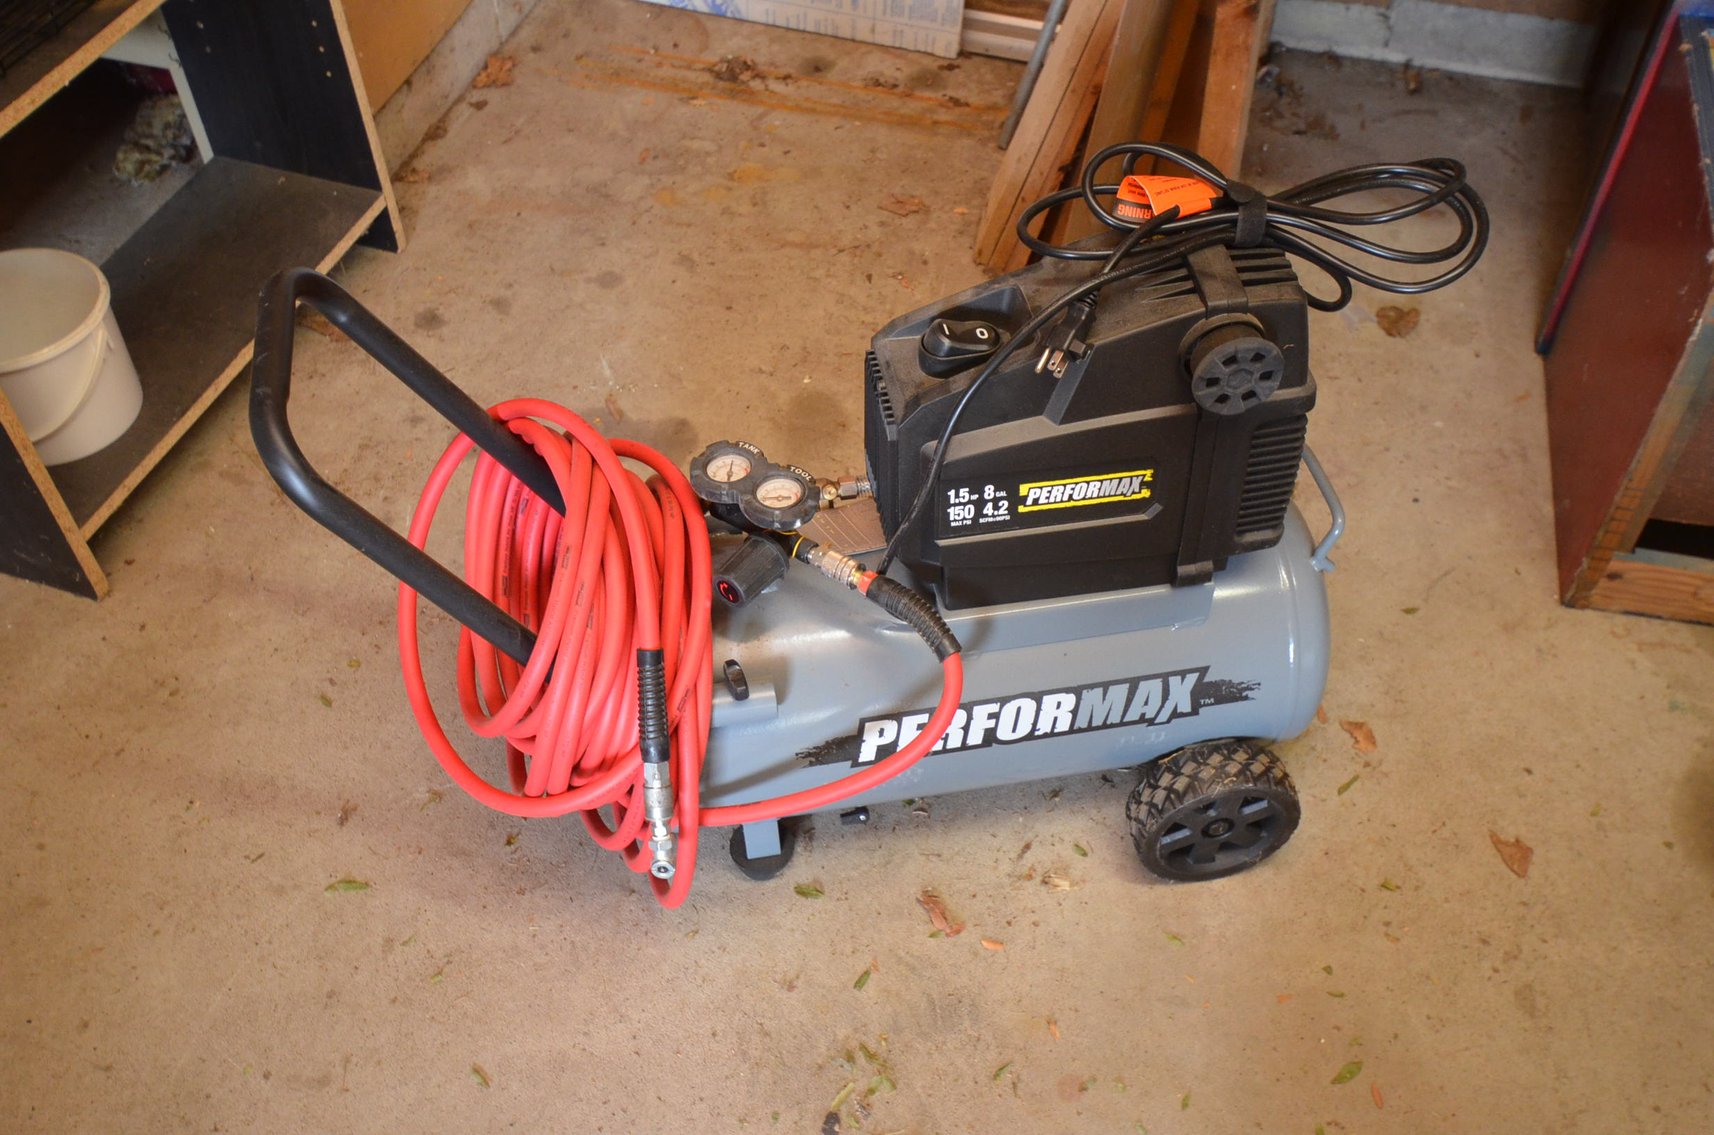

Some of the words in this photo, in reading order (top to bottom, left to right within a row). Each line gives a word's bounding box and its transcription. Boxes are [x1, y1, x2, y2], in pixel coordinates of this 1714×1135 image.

[738, 441, 761, 455] TANK
[789, 465, 812, 481] TOOL
[947, 487, 970, 504] 1.5
[983, 484, 995, 500] 8
[1025, 474, 1145, 507] PERFORMAX
[946, 504, 975, 521] 150
[982, 500, 1009, 516] 4.2
[857, 671, 1202, 764] PERFORMAX
